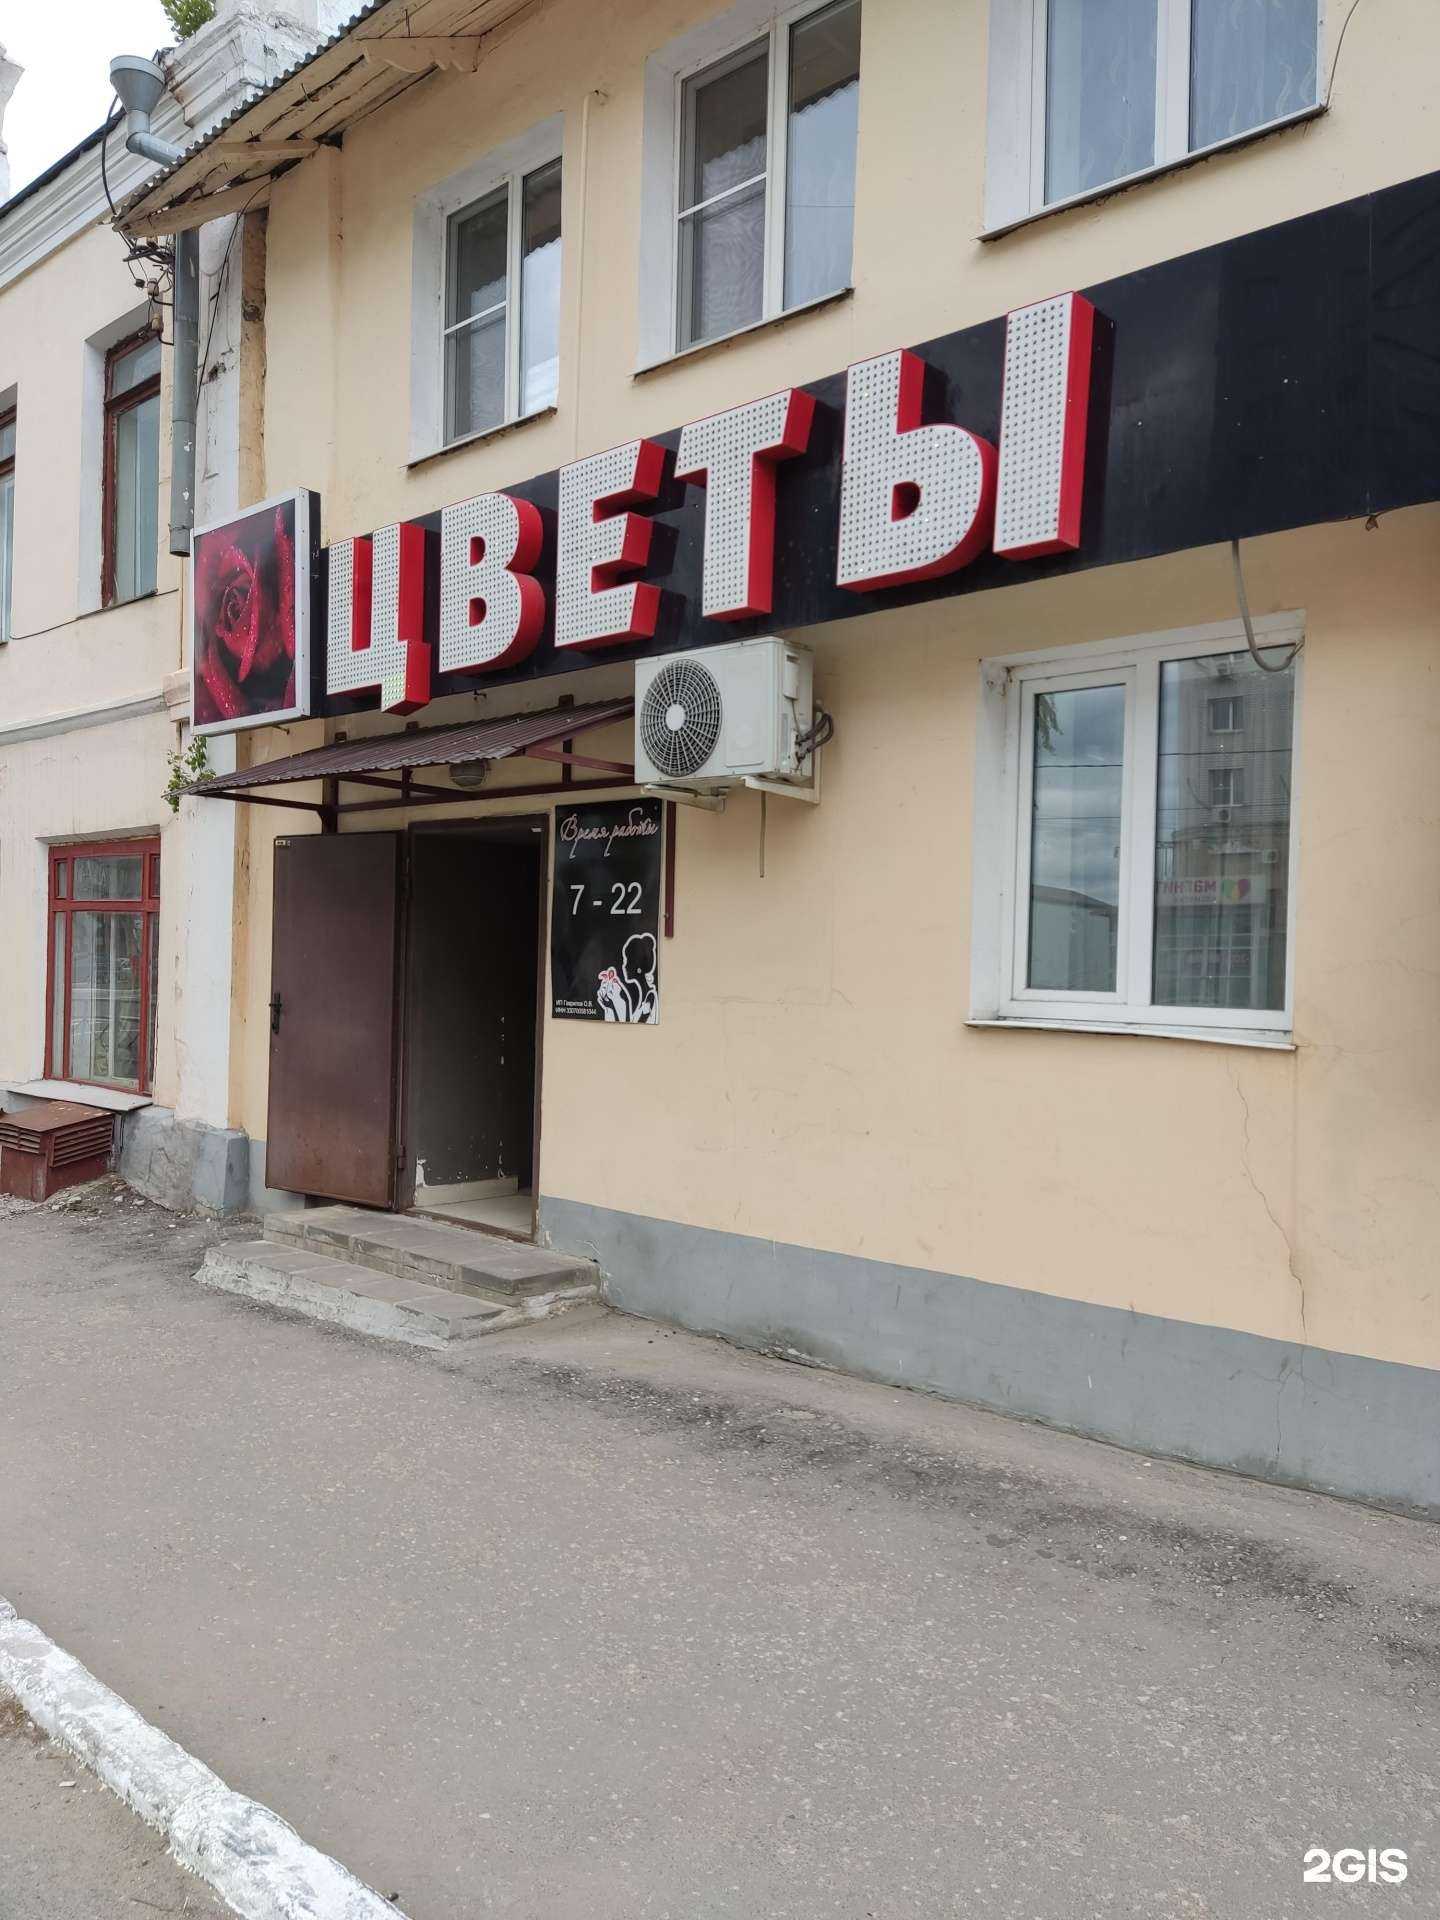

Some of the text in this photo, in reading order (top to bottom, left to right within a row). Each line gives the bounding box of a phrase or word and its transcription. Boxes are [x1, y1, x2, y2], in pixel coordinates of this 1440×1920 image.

[325, 291, 1096, 716] ЦВЕТЫ
[560, 807, 658, 859] Время работы
[570, 884, 585, 915] 7
[610, 882, 642, 915] 22
